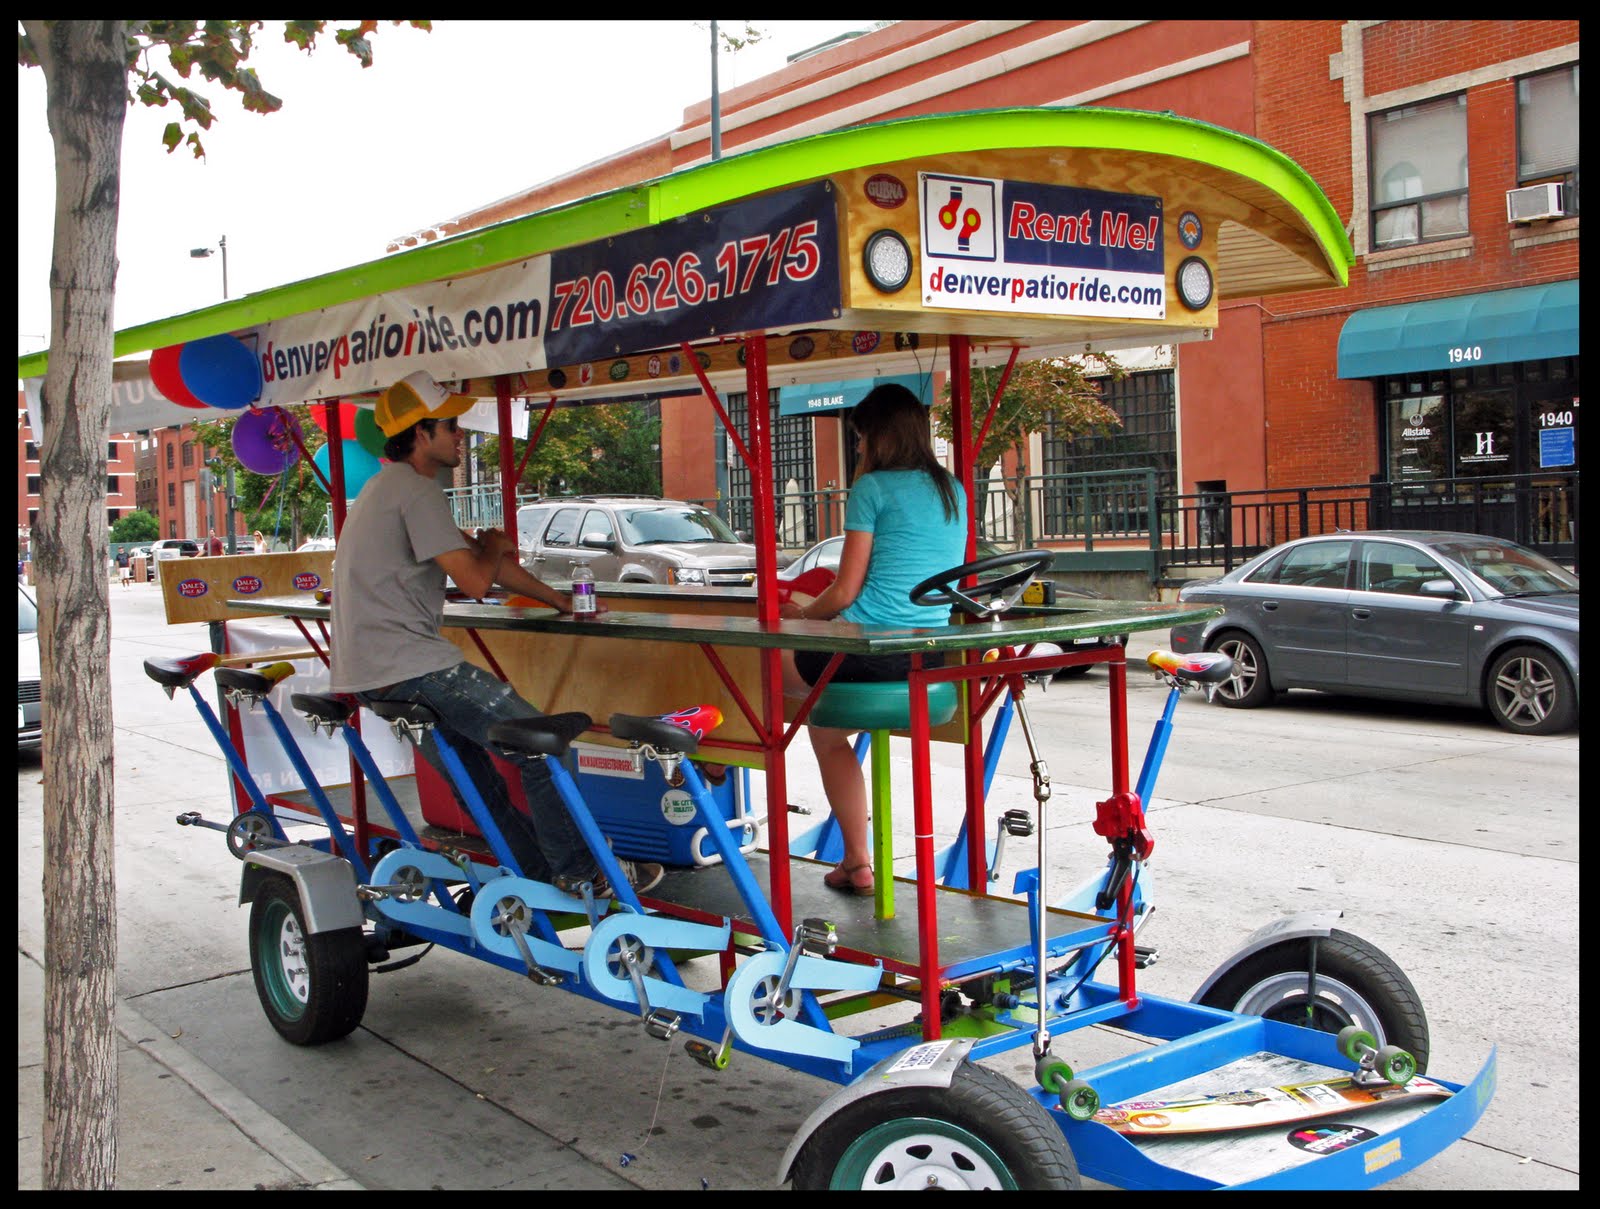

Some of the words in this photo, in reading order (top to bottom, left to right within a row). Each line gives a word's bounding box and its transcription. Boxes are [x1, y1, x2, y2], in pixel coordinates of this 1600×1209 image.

[1008, 200, 1092, 246] Rent
[1100, 210, 1159, 251] Me!
[550, 219, 822, 332] 720.626.1715
[929, 266, 1162, 306] denverpatioride.com
[262, 298, 542, 384] denverpatioride.com
[1448, 346, 1482, 363] 1940
[808, 398, 822, 408] 1948
[823, 395, 844, 407] BLAKE
[1401, 427, 1431, 437] Allstate
[1539, 411, 1573, 427] 1940
